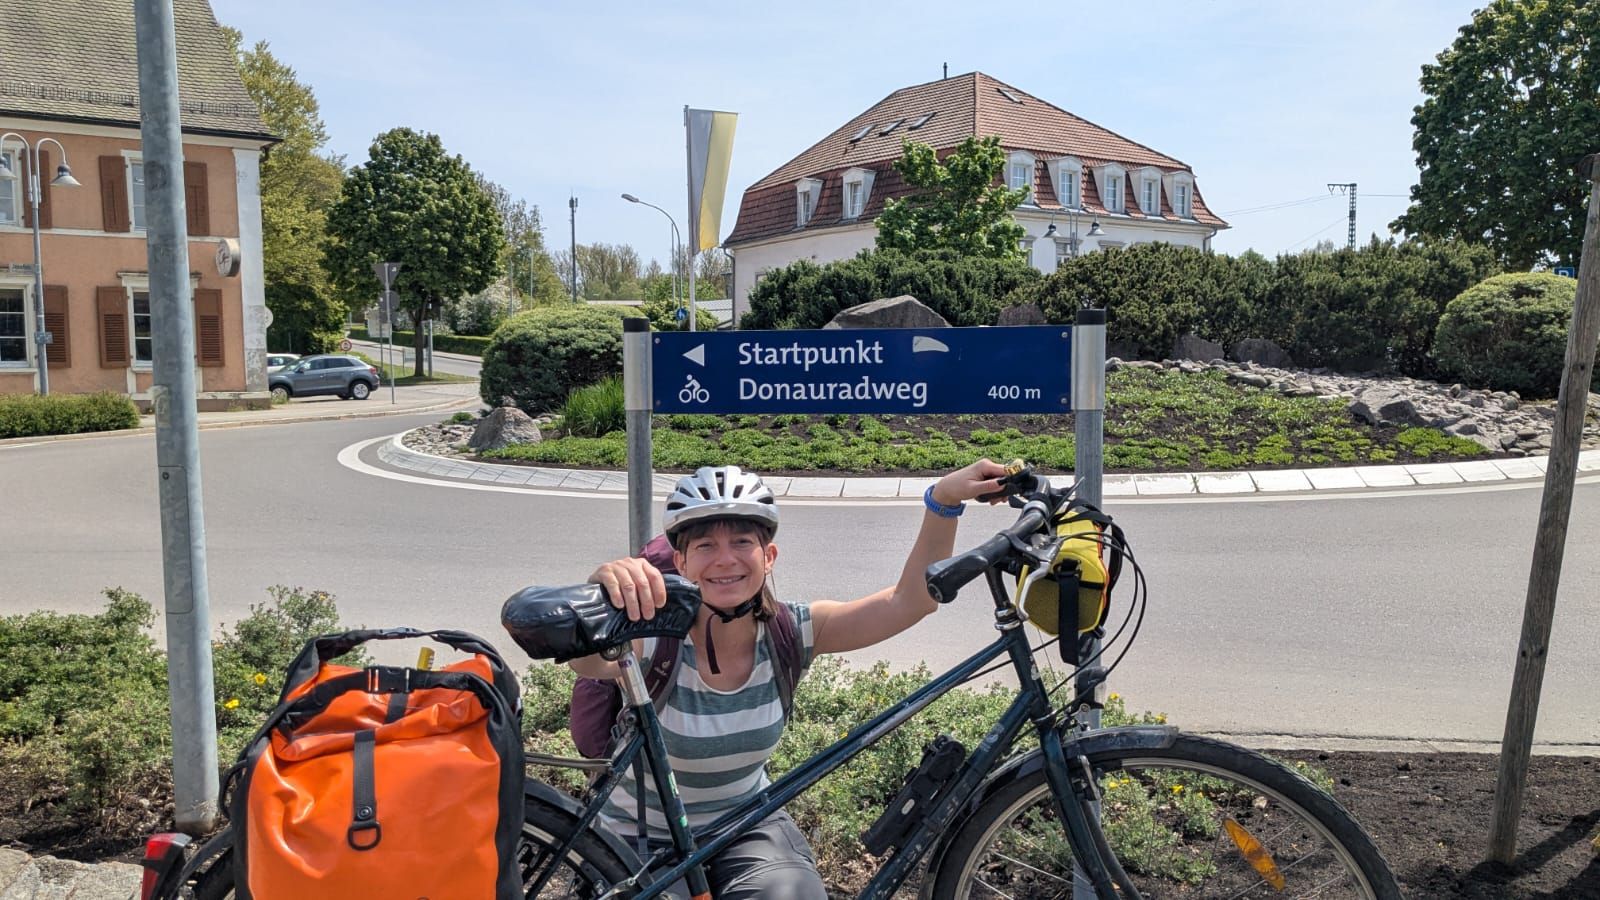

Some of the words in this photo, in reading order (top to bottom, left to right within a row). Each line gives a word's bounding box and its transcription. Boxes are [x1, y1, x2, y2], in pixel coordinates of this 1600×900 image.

[737, 340, 884, 371] Startpunkt
[738, 376, 928, 408] Donauradweg
[987, 385, 1020, 400] 400
[1024, 388, 1042, 399] m
